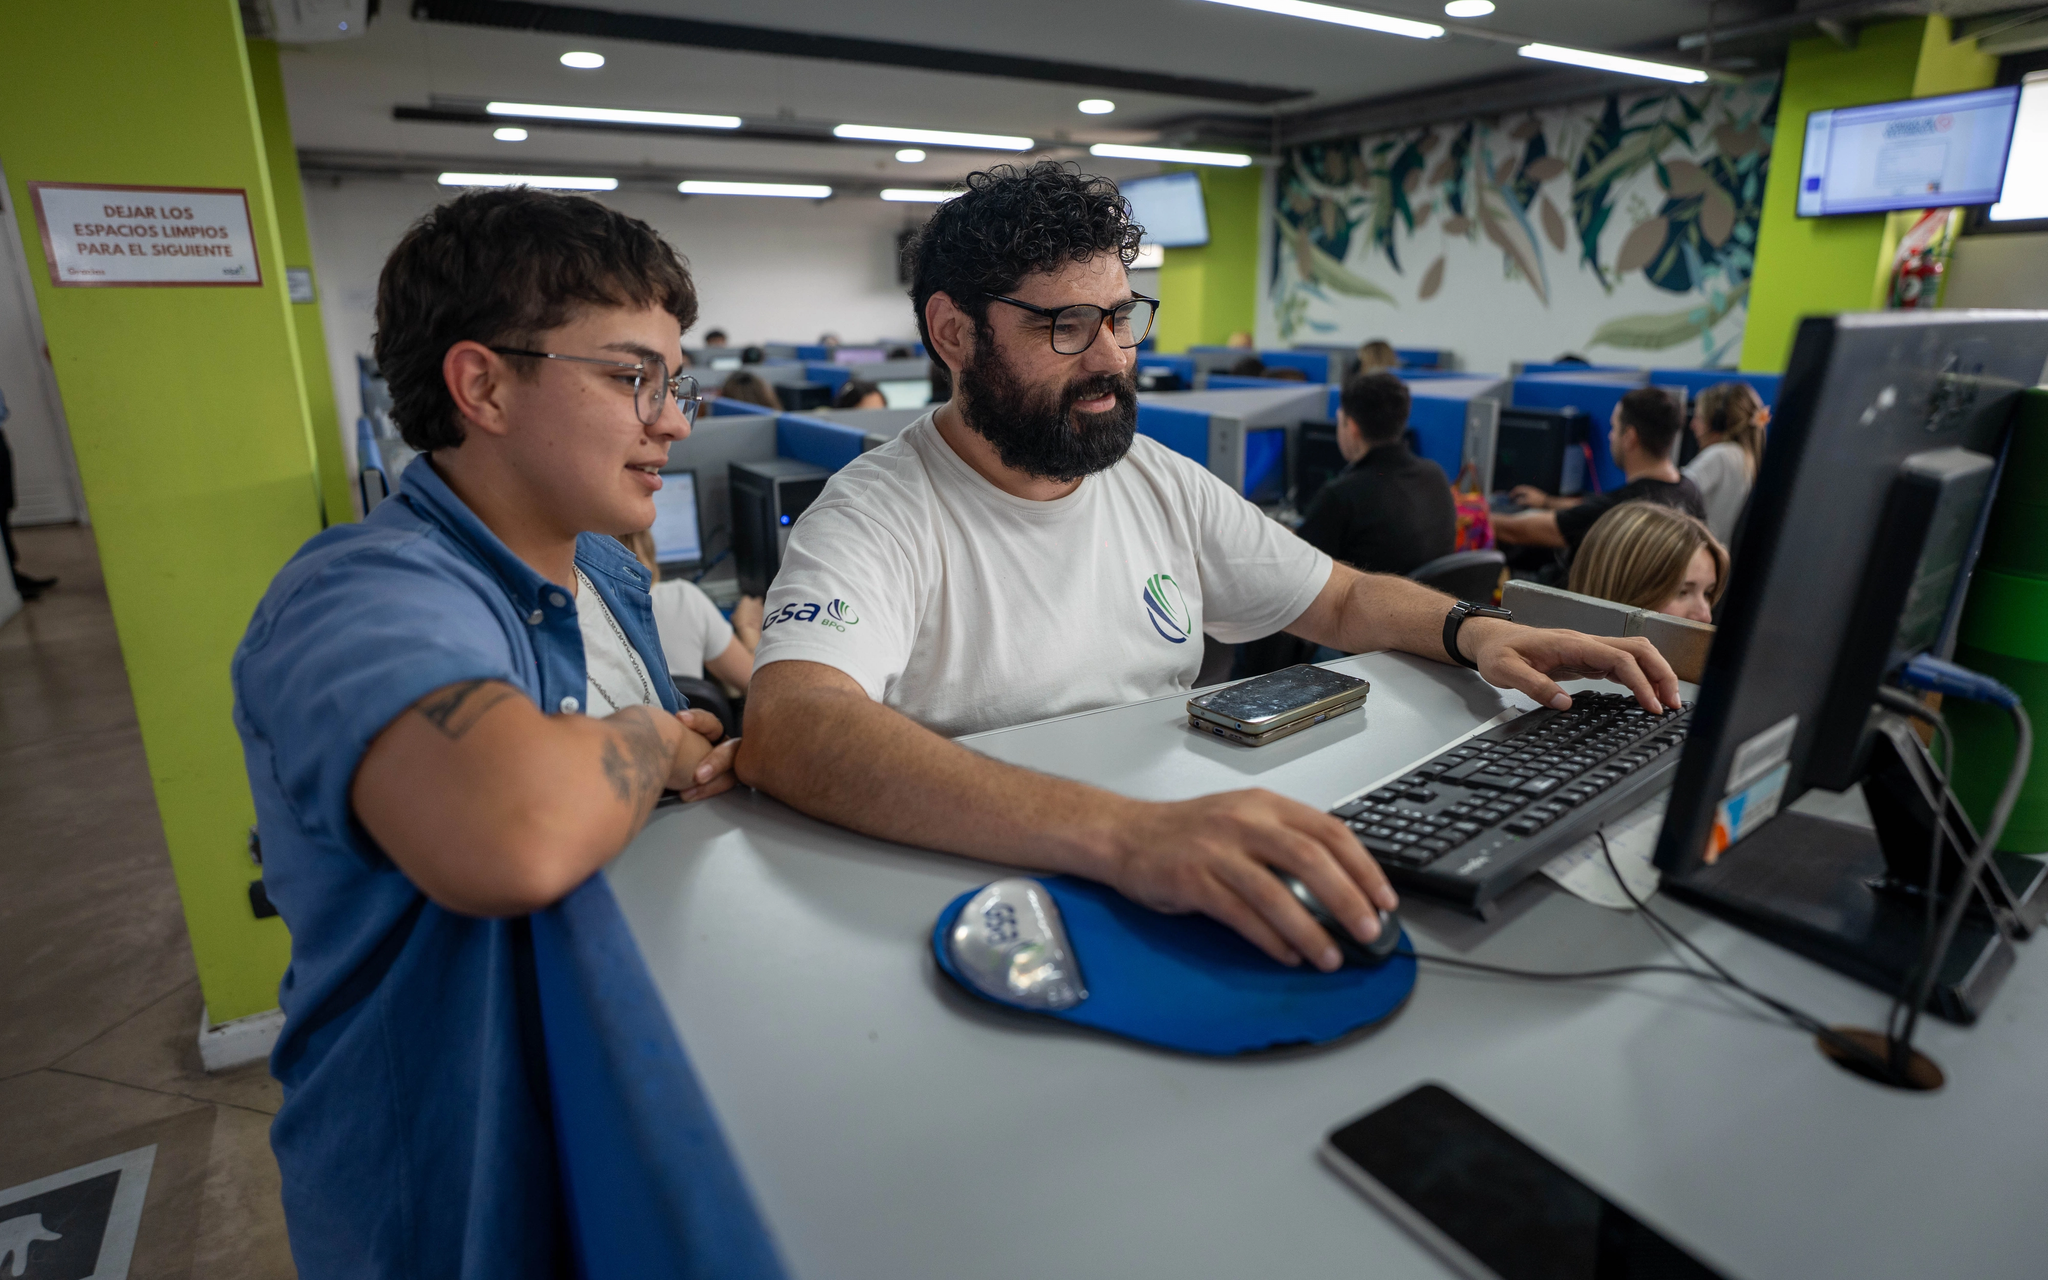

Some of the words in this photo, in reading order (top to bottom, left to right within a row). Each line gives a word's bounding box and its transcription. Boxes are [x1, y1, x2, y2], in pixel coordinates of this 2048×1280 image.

[104, 205, 157, 219] DEJAR
[160, 206, 194, 220] LOS
[74, 223, 159, 238] ESPACIOS
[162, 225, 228, 239] LIMPIOS
[77, 242, 125, 256] PARA
[128, 243, 147, 256] EL
[151, 243, 233, 257] SIGUIENTE
[821, 618, 846, 633] BPO
